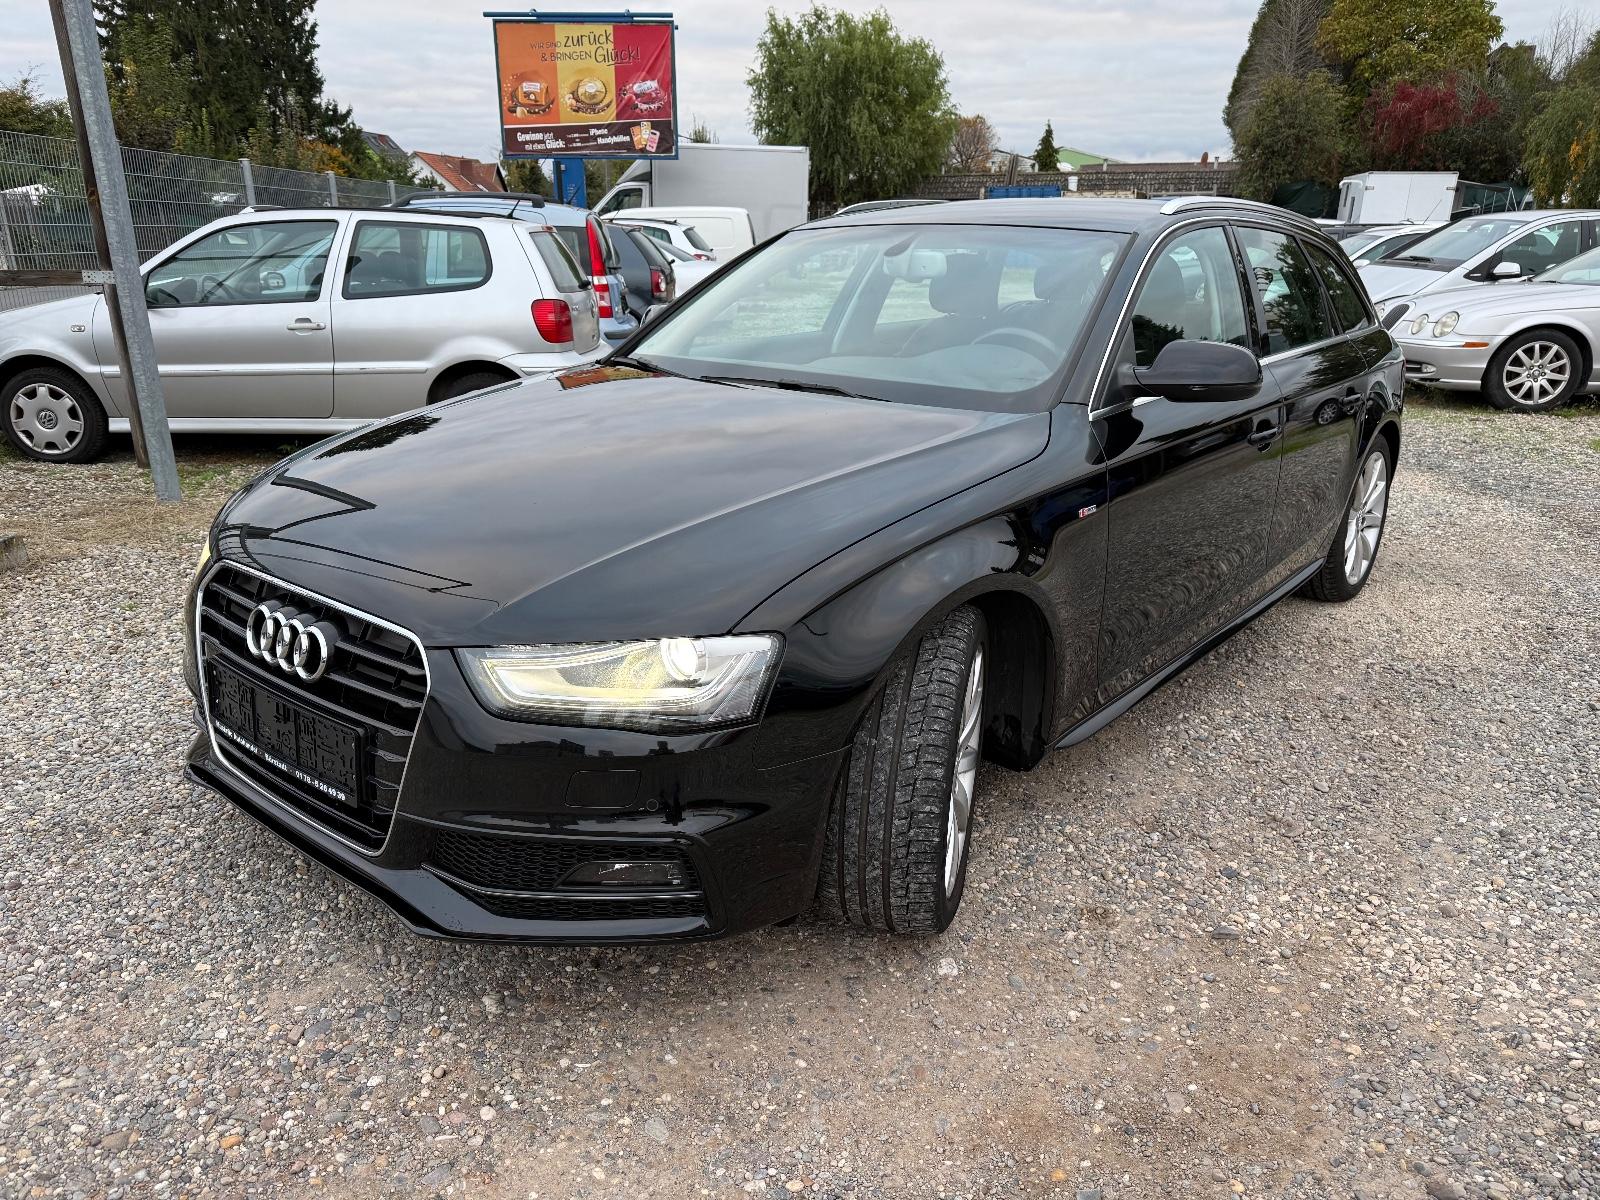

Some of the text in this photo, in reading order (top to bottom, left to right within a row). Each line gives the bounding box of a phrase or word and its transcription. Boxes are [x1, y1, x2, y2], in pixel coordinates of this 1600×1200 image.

[530, 41, 543, 49] WIR
[564, 29, 613, 48] zurück
[550, 50, 592, 62] BRINGEN
[594, 44, 640, 66] Glück!
[517, 131, 544, 141] Gewinne
